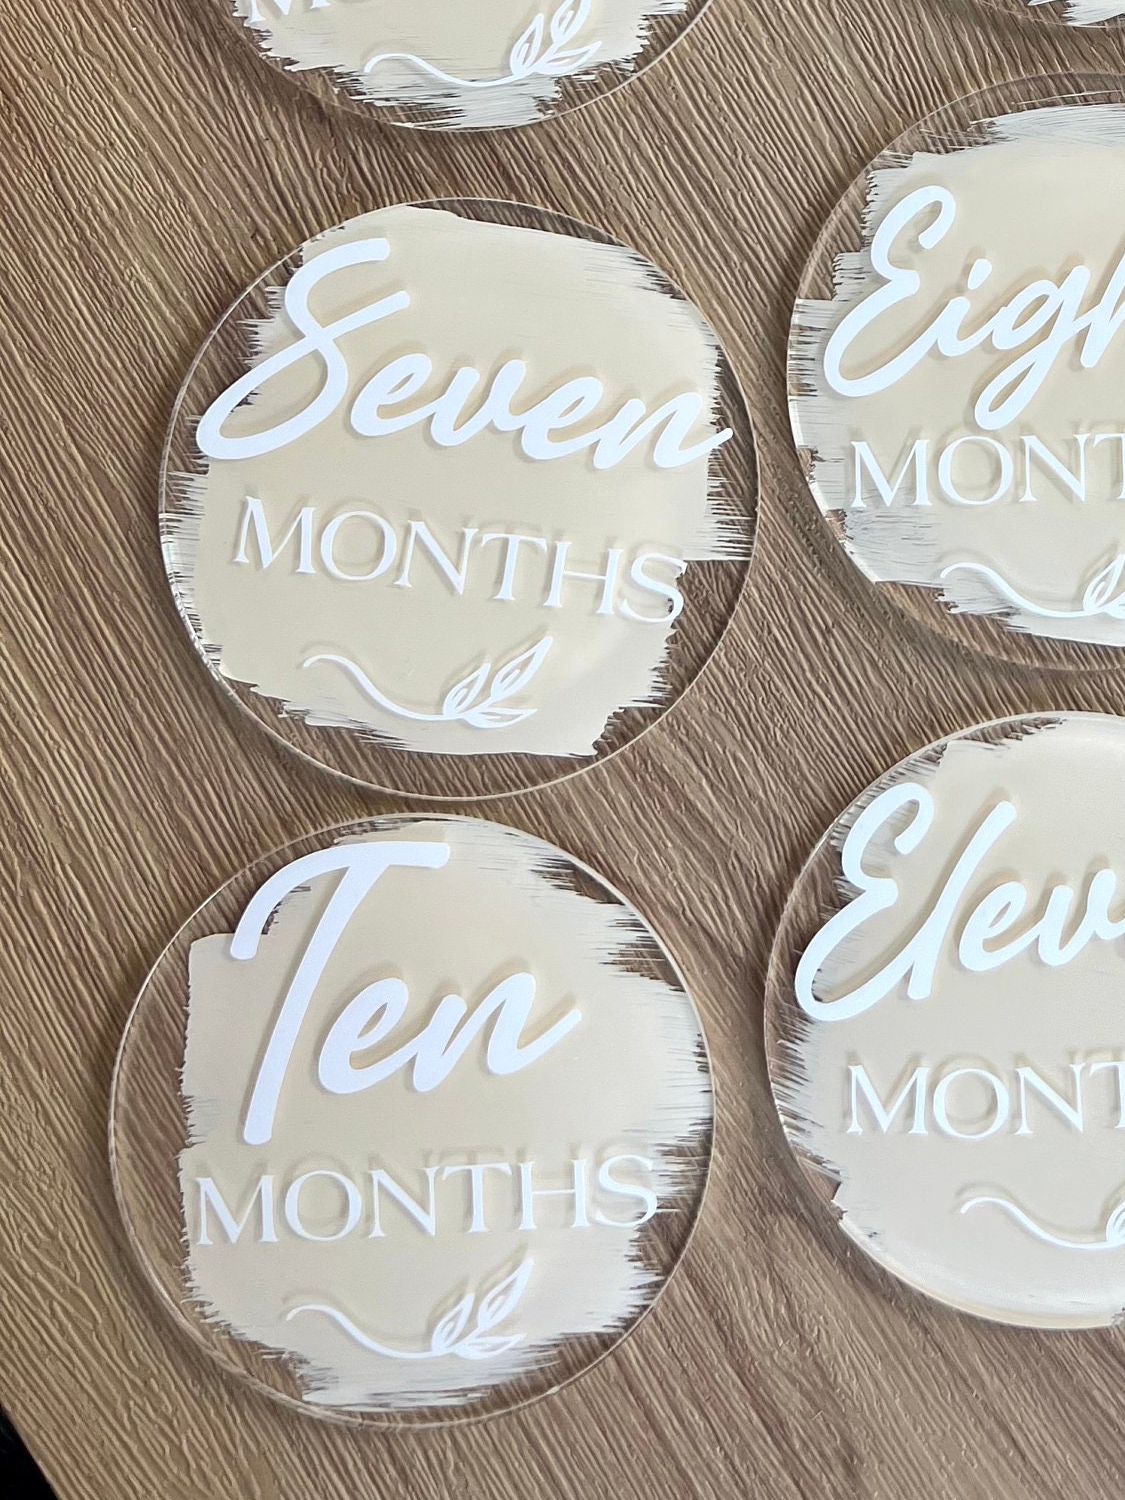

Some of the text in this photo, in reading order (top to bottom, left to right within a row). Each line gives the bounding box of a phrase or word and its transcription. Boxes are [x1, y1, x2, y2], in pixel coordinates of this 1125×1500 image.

[196, 238, 733, 469] Seven
[234, 495, 687, 624] MONTHS
[230, 841, 582, 1145] Ten
[196, 1154, 659, 1246] MONTHS
